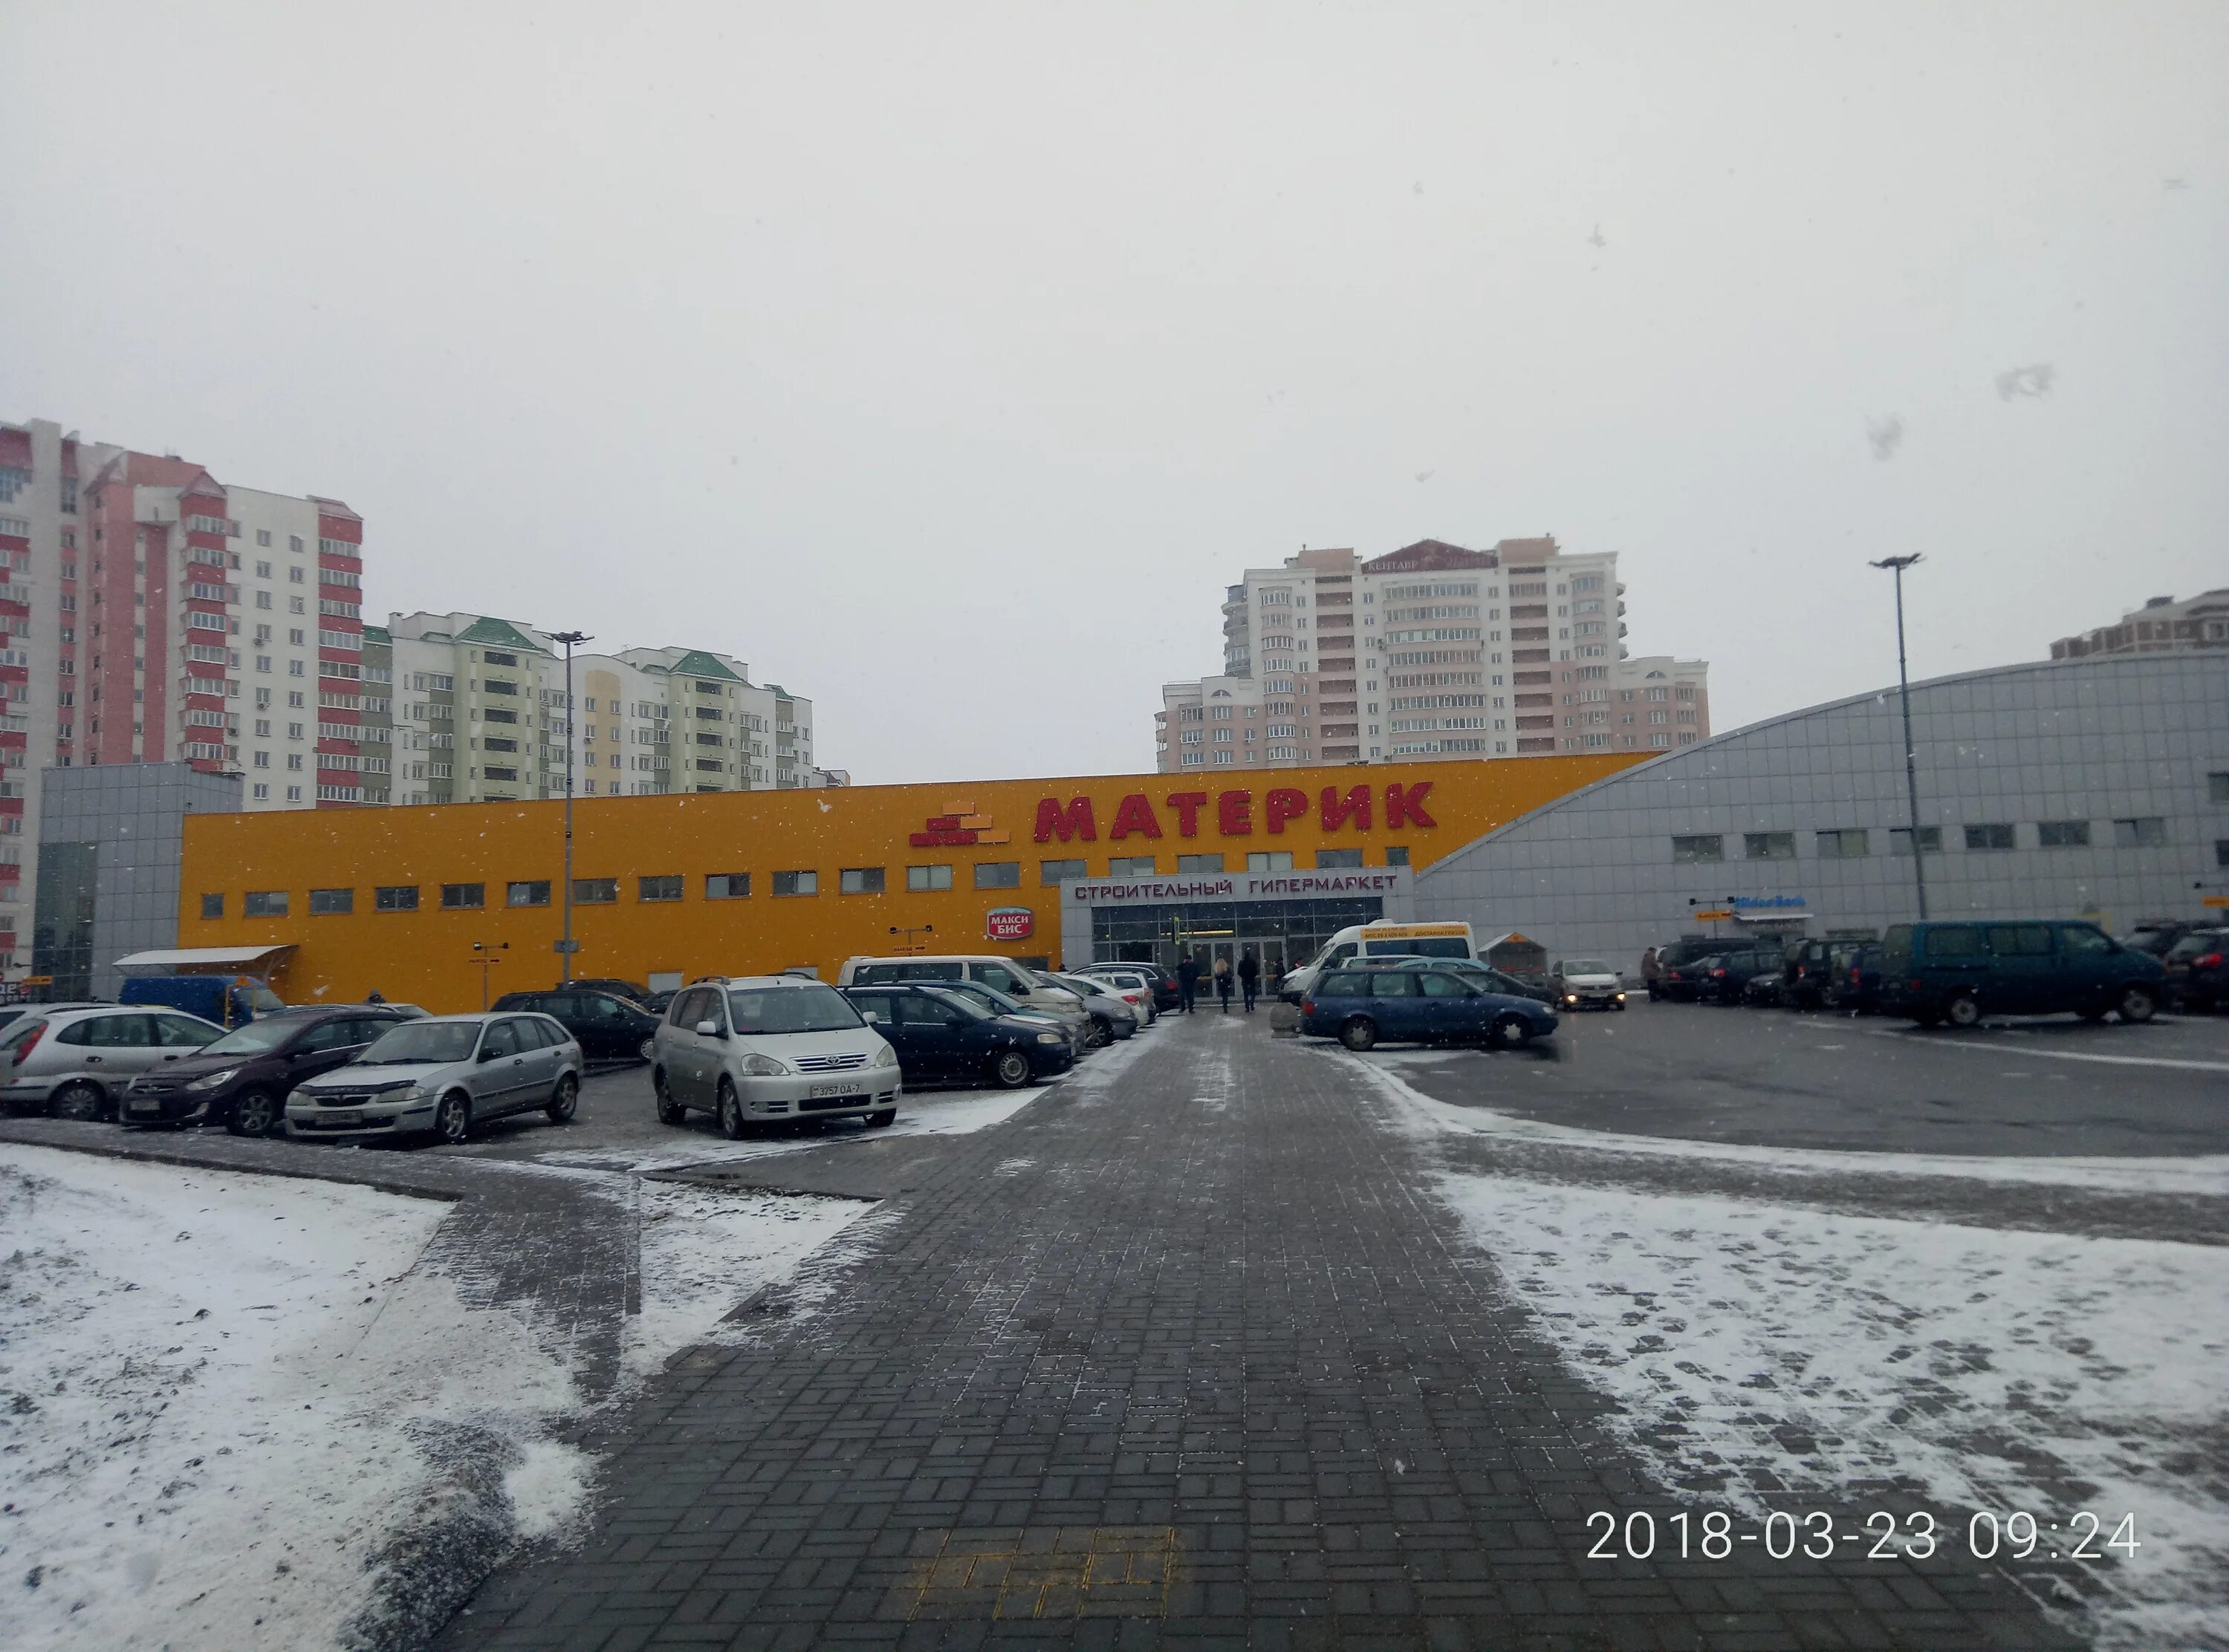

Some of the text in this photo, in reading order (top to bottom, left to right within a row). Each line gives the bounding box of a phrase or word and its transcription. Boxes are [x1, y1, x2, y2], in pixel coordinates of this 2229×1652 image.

[1368, 561, 1418, 571] КЕНТАВР
[1034, 781, 1438, 842] МАТЕРИК
[1075, 874, 1397, 900] СТРОИТЕЛЬНЫЙ ГИПЕРМАРКЕТ
[991, 916, 1029, 925] МАКСИ
[997, 924, 1023, 934] БИС
[820, 1086, 838, 1096] 3757
